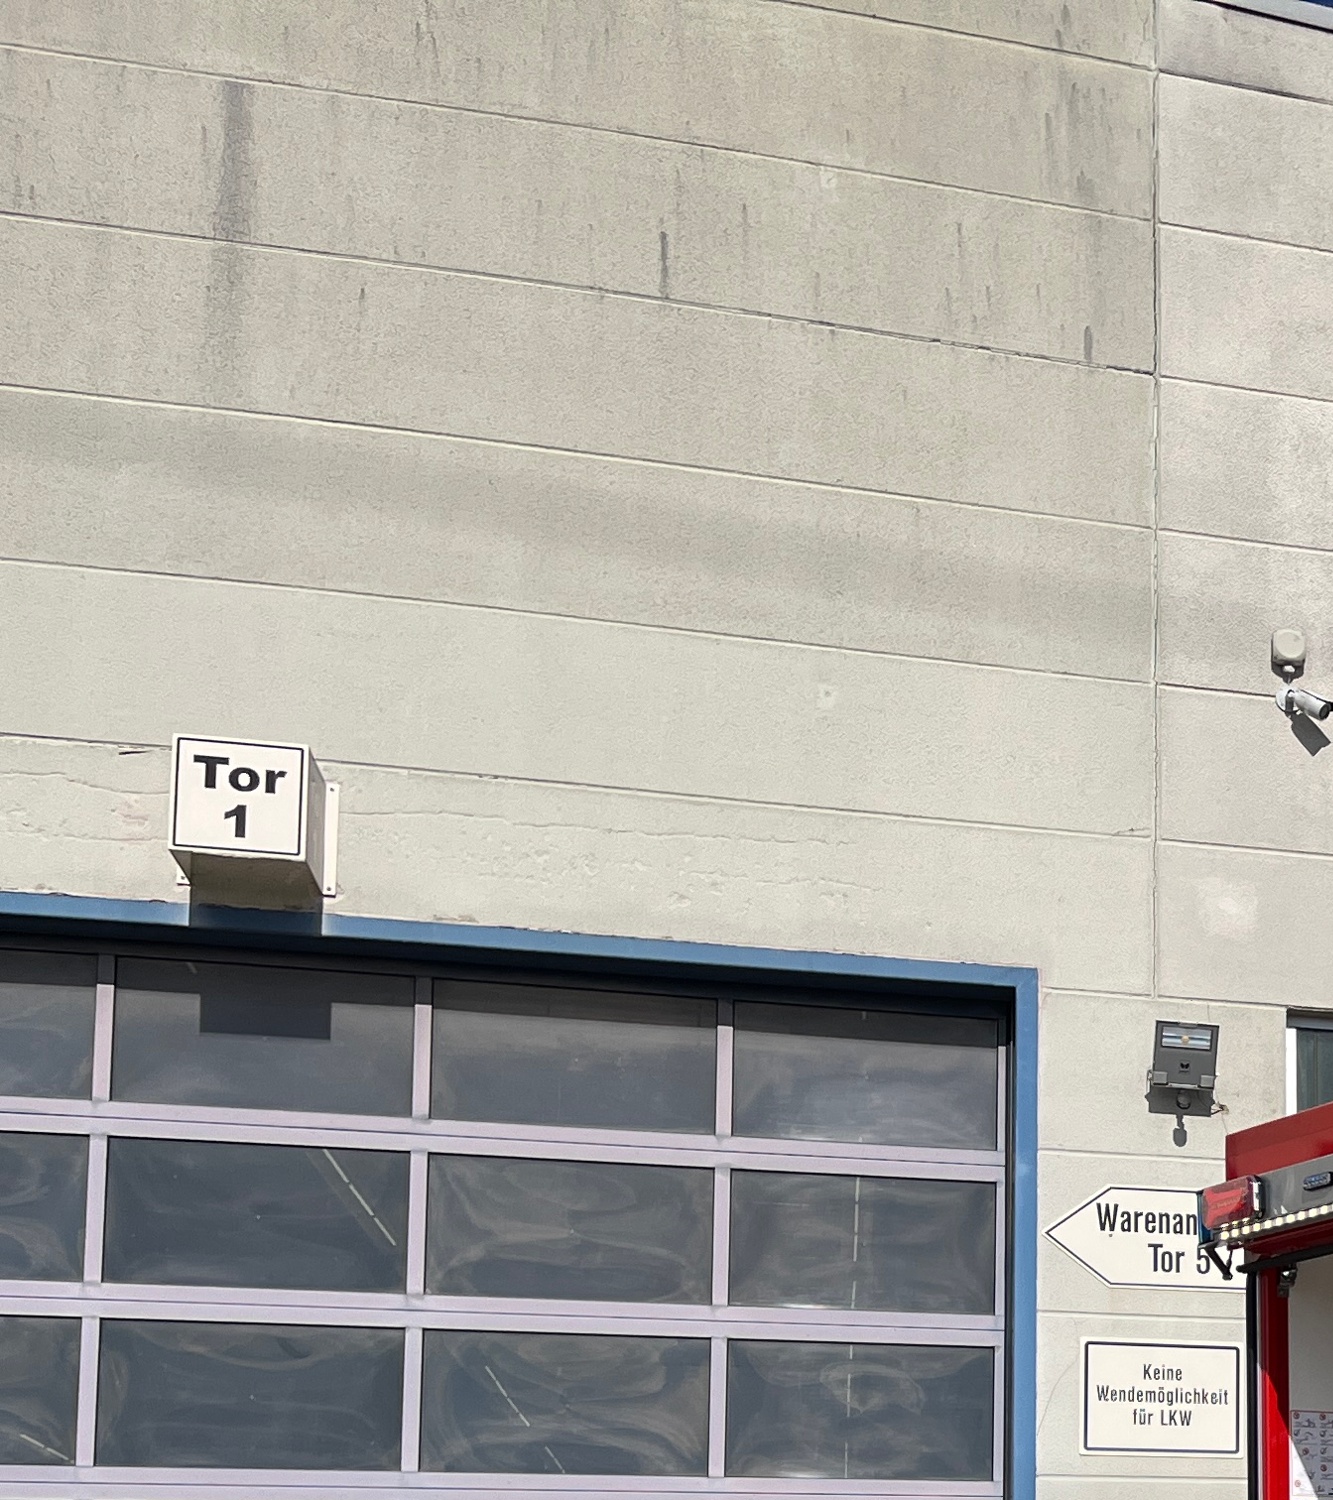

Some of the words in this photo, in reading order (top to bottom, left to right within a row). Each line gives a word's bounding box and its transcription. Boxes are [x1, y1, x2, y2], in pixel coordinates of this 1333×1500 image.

[193, 754, 287, 794] Tor
[224, 804, 247, 838] 1
[1148, 1243, 1185, 1274] Tor
[1143, 1364, 1183, 1381] Keine
[1096, 1385, 1229, 1407] Wendemöglichkeit
[1133, 1409, 1154, 1426] für
[1160, 1410, 1193, 1427] LKW
